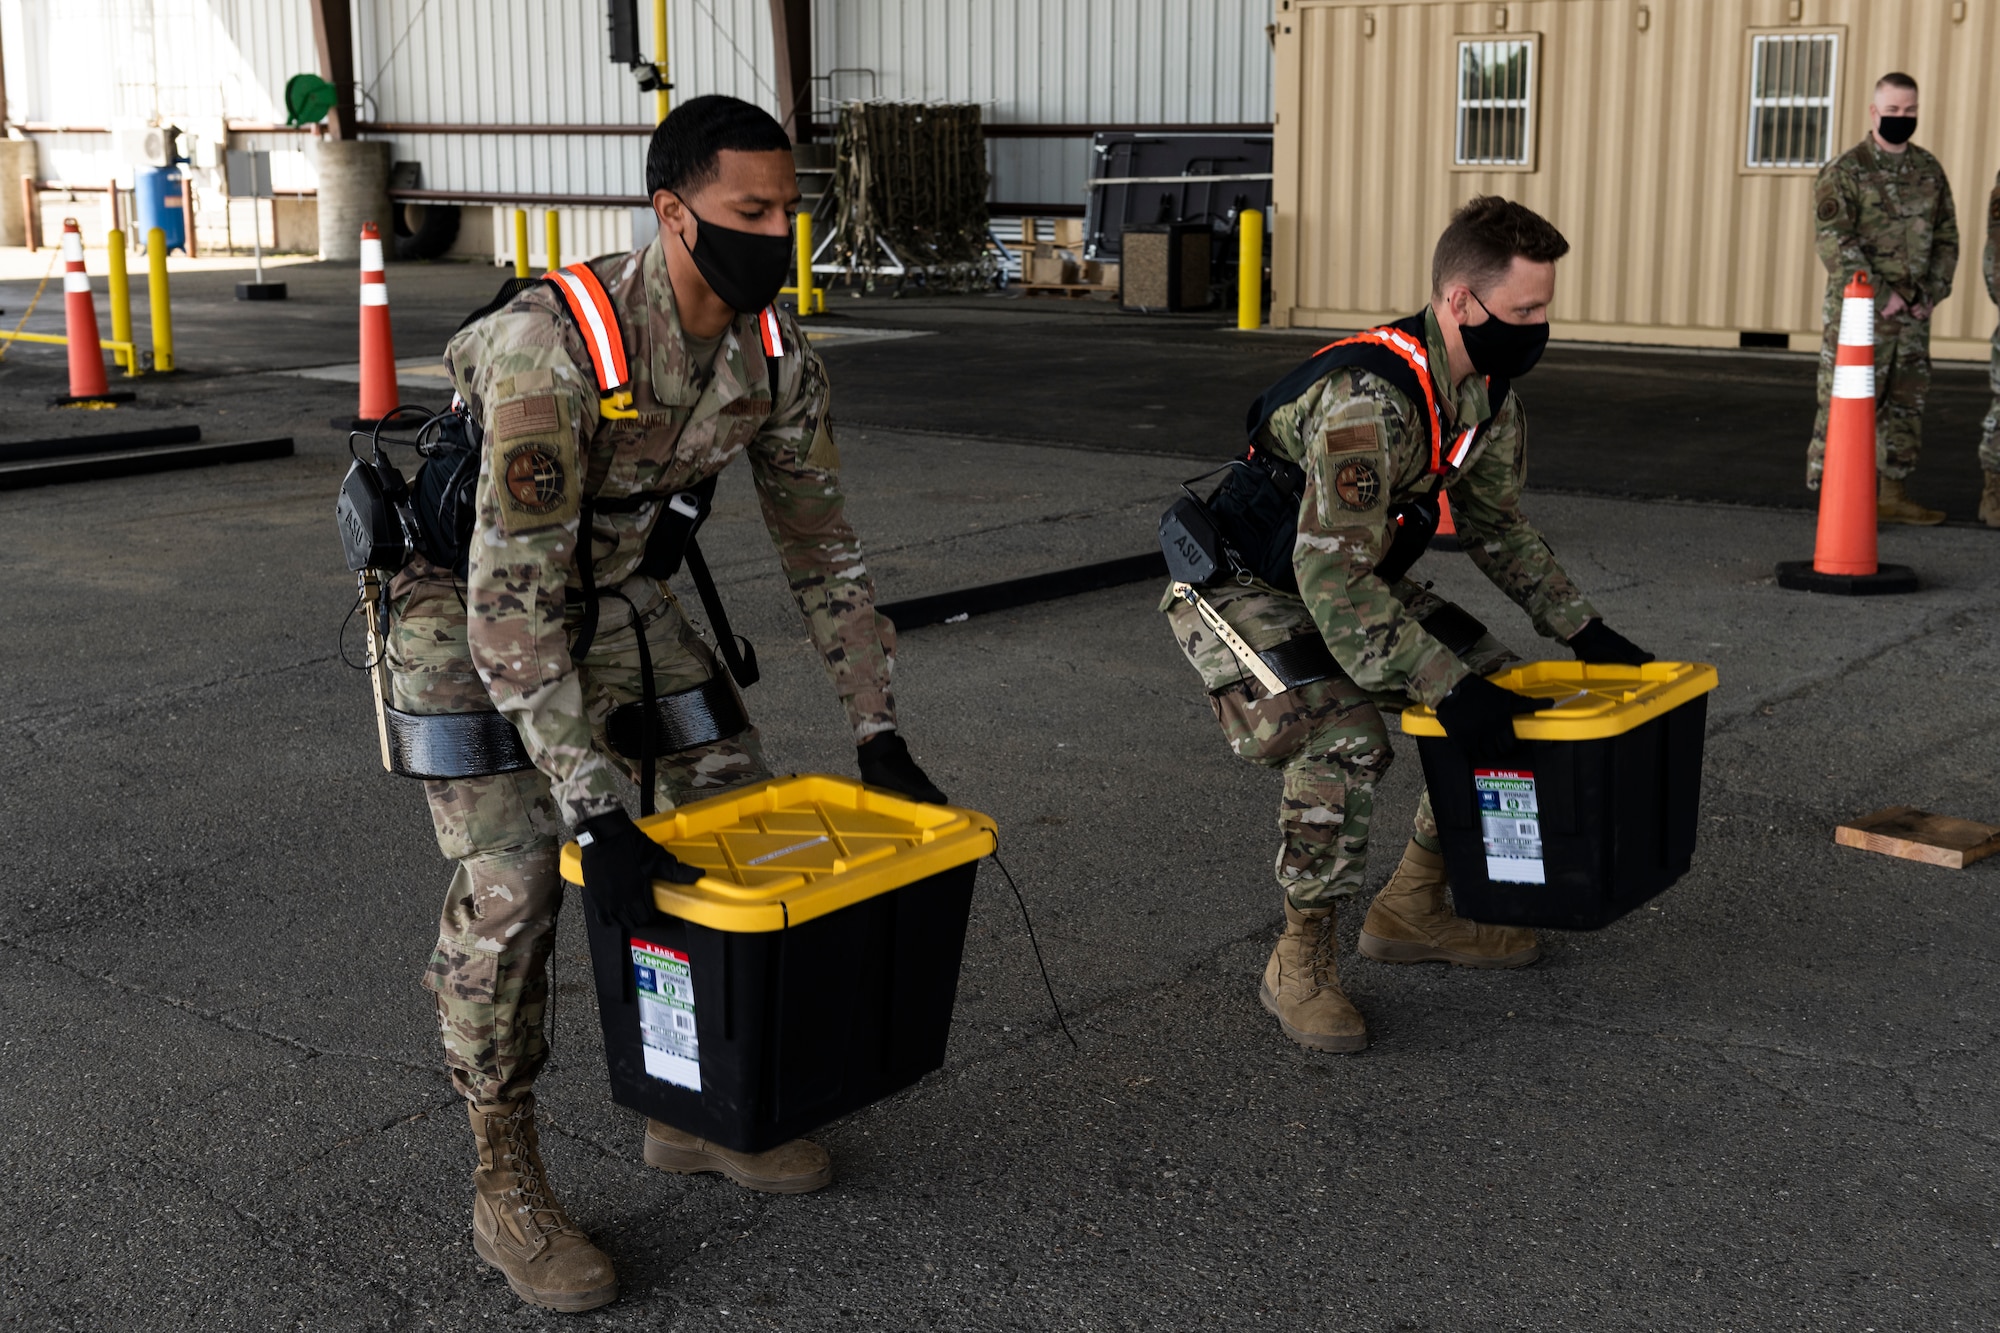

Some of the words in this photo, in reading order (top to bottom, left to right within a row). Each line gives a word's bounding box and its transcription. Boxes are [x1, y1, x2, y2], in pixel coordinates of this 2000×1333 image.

[344, 510, 364, 546] ASU
[1173, 535, 1203, 566] ASU
[635, 951, 687, 975] Greenmade
